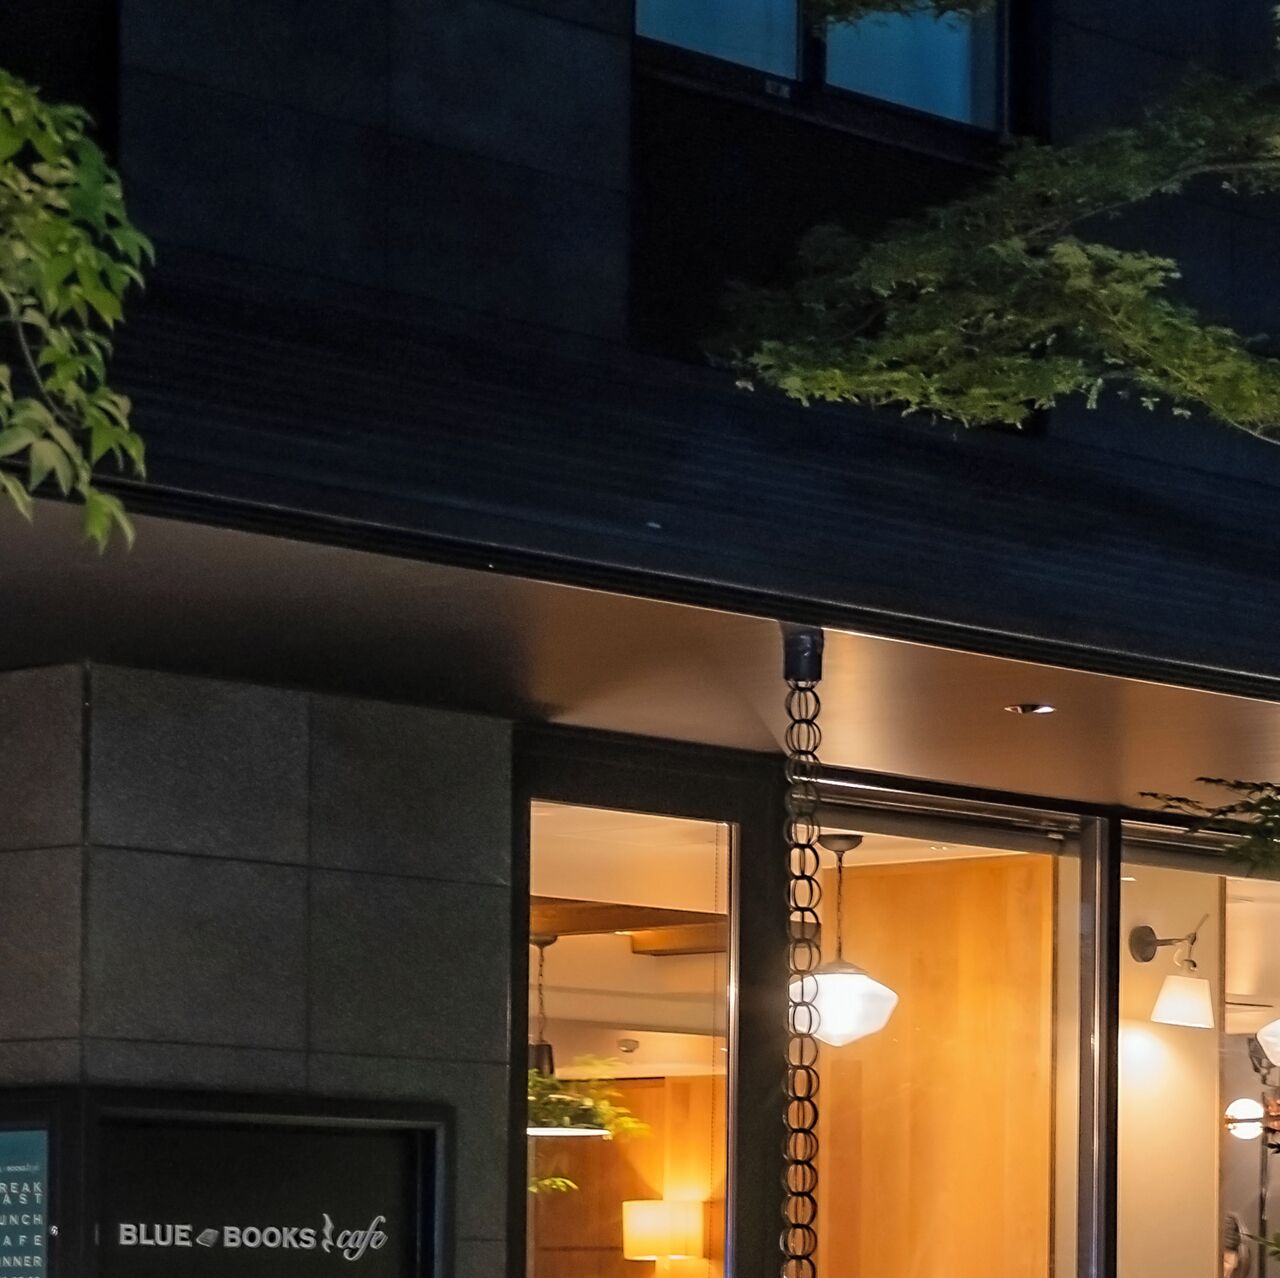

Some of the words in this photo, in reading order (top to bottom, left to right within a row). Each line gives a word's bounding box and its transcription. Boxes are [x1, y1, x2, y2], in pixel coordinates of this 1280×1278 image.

[119, 1223, 193, 1247] BLUE
[223, 1225, 317, 1249] BOOKS
[336, 1215, 389, 1261] cafe
